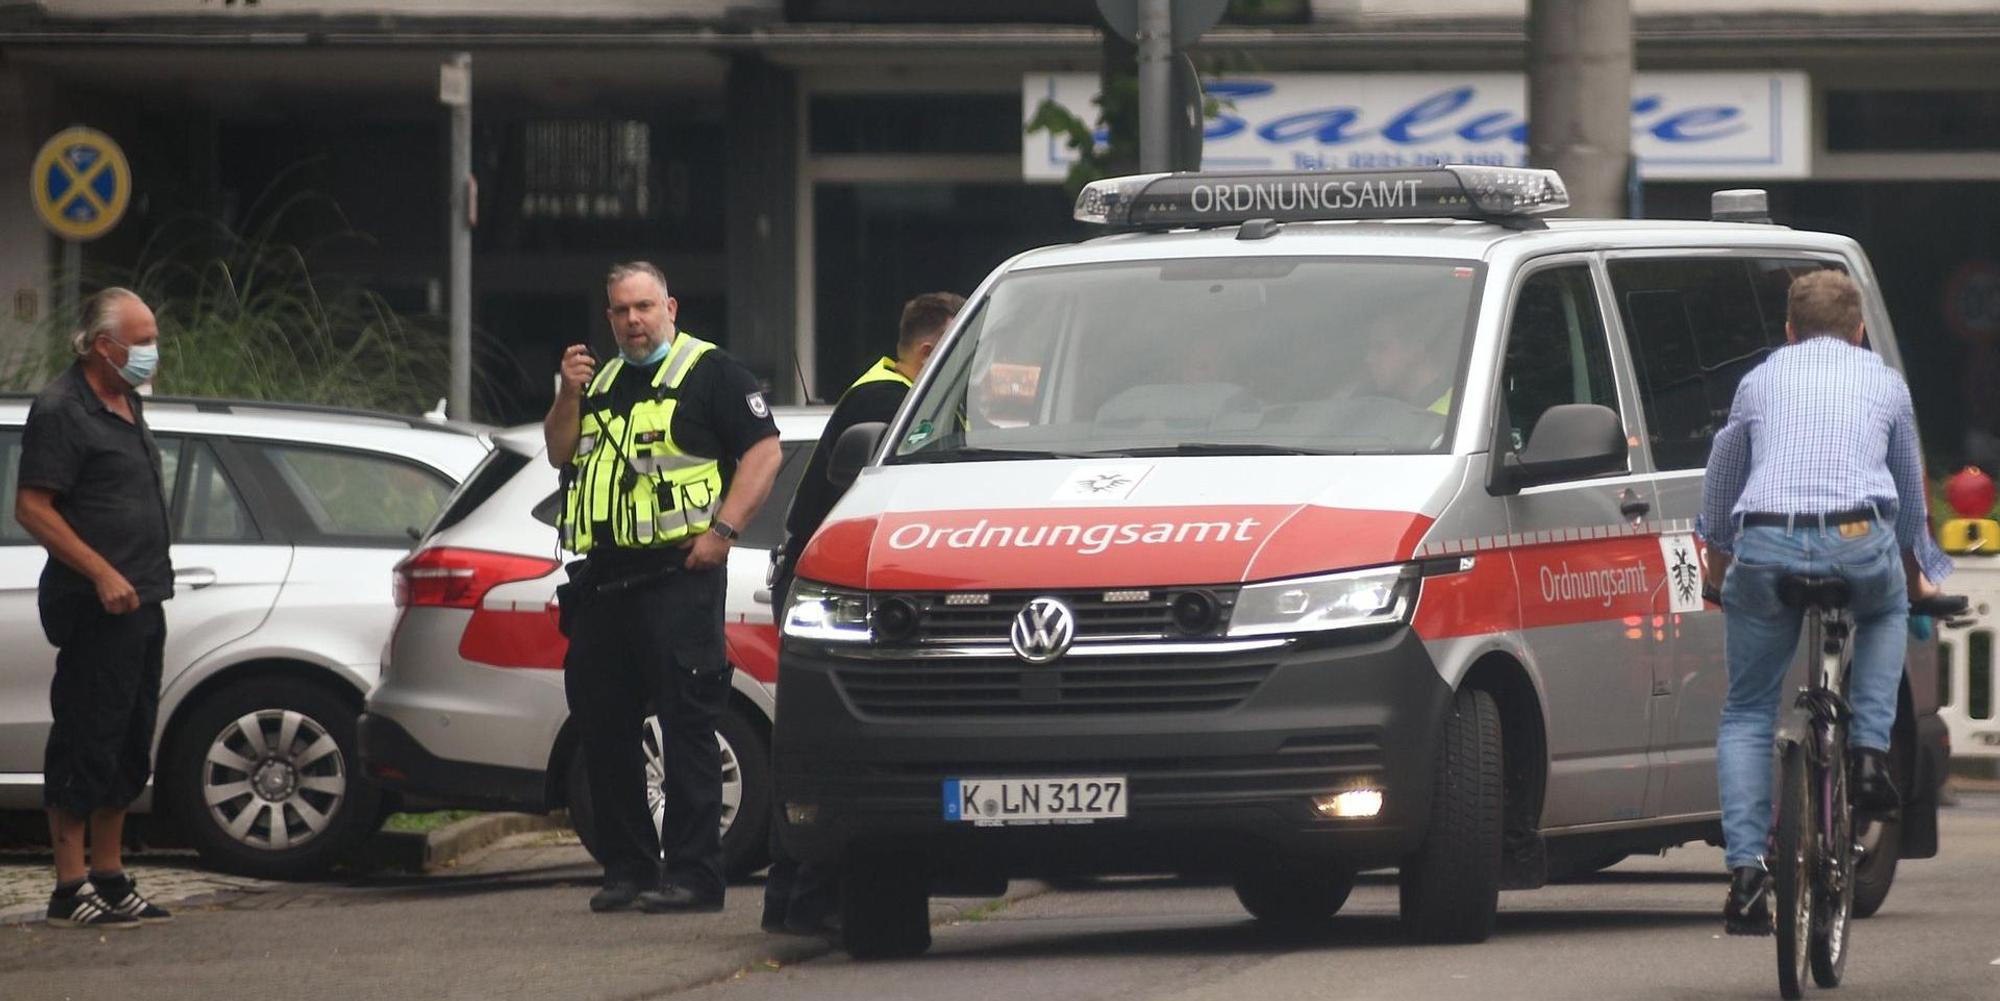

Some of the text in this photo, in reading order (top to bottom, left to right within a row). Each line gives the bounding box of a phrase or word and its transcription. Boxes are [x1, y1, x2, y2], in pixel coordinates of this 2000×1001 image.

[1191, 179, 1423, 212] ORDNUNGSAMT
[888, 515, 1262, 555] Ordnungsamt
[1539, 560, 1649, 607] Ordnungsamt
[963, 785, 981, 815] K
[1001, 784, 1040, 814] LN
[1047, 782, 1122, 814] 3127
